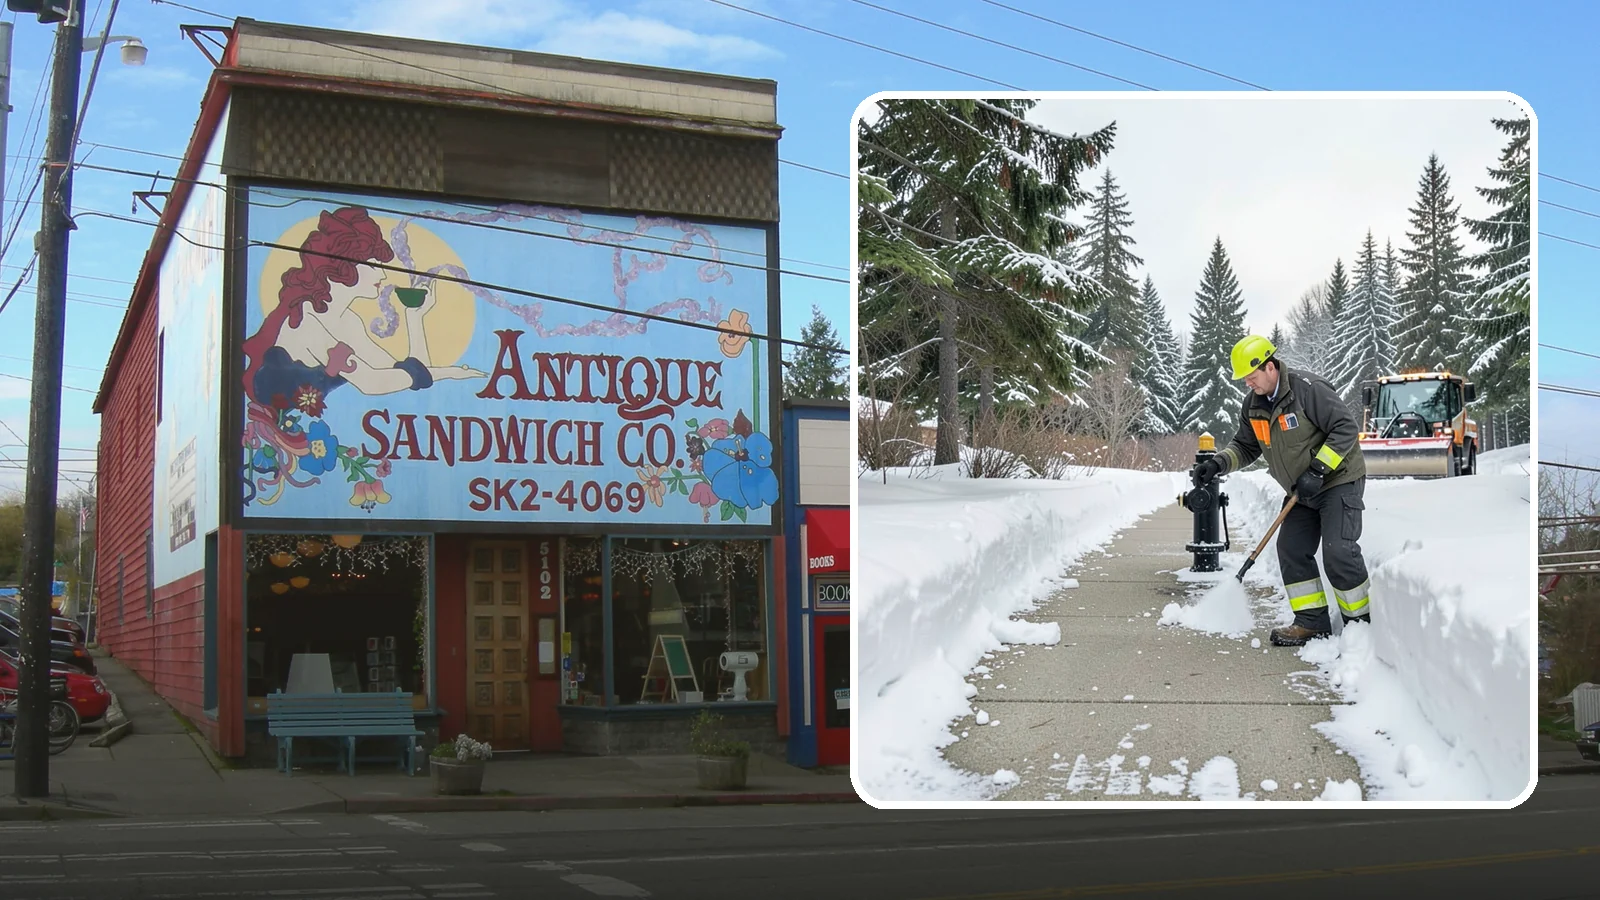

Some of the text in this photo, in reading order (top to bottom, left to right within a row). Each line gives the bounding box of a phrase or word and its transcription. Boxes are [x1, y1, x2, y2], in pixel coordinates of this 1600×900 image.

[476, 329, 723, 420] ANTIQUE
[361, 408, 684, 468] SANDWICH CO.
[469, 477, 645, 513] SK2-4069
[539, 542, 551, 599] 5102
[809, 555, 835, 569] BOOKS
